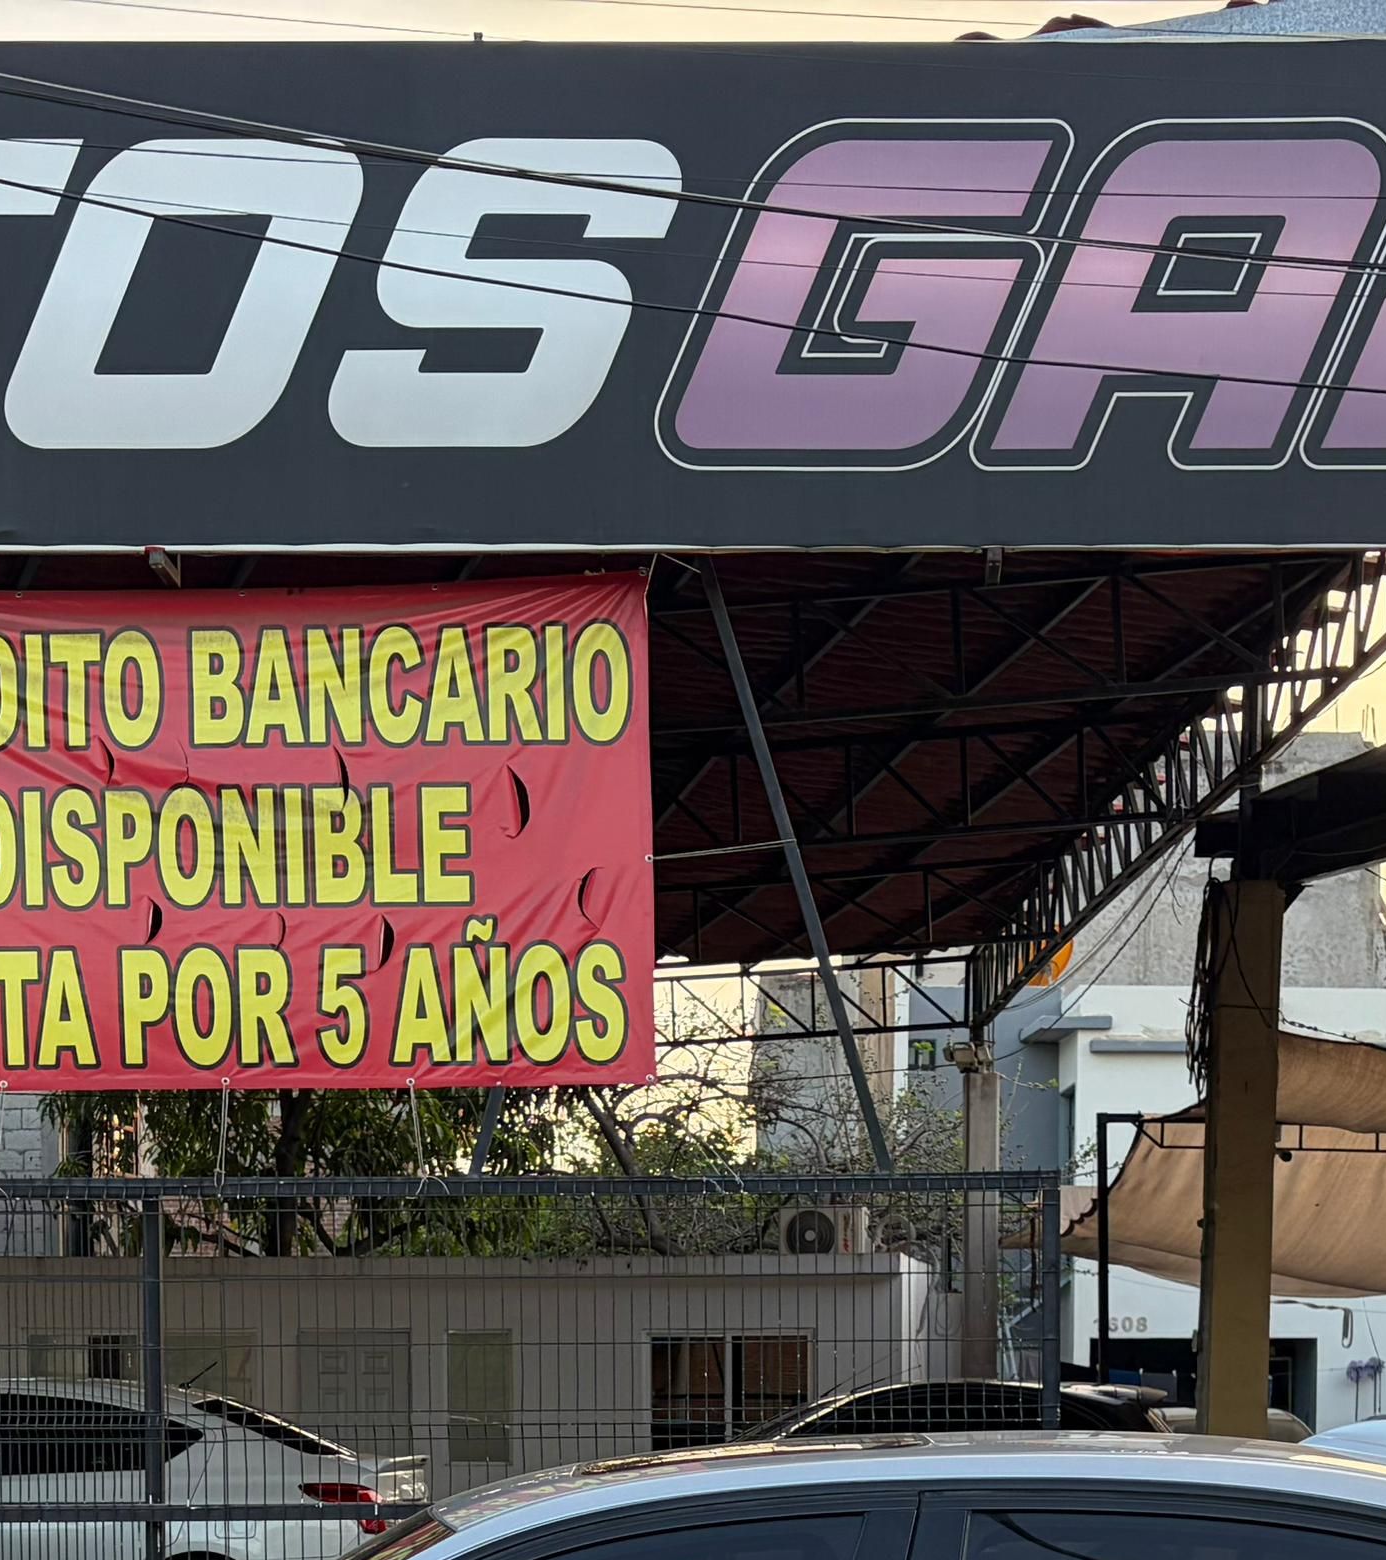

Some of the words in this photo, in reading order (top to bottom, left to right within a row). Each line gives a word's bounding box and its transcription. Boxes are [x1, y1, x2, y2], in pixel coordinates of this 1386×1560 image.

[191, 622, 632, 746] BANCARIO
[121, 948, 298, 1067] POR
[319, 947, 368, 1066] 5
[393, 918, 628, 1066] AÑOS
